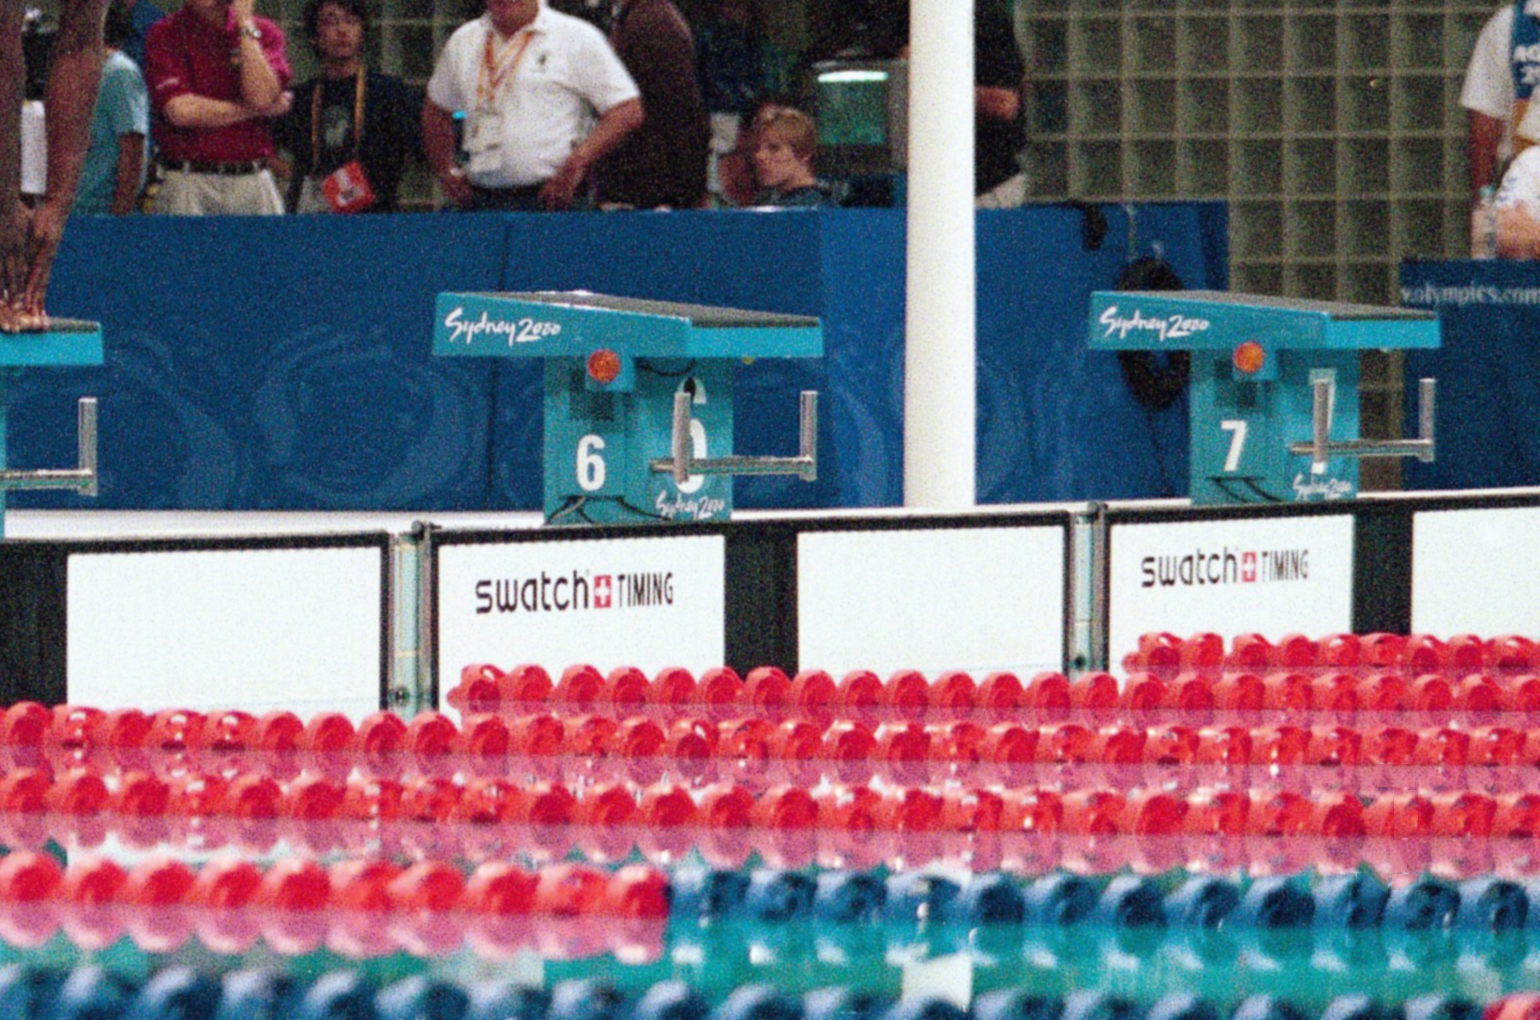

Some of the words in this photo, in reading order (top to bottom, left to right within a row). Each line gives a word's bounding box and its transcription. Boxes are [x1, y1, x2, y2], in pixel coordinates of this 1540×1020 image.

[444, 307, 516, 347] Sydney
[515, 318, 561, 342] 2000
[1099, 306, 1167, 341] Sydney
[1165, 314, 1211, 338] 2000
[576, 433, 606, 492] 6
[1220, 419, 1249, 472] 7
[655, 489, 699, 521] Sydney
[1141, 546, 1239, 589] swatch
[1261, 548, 1310, 583] TIMING
[475, 569, 590, 615] swatch
[617, 571, 674, 609] TIMING
